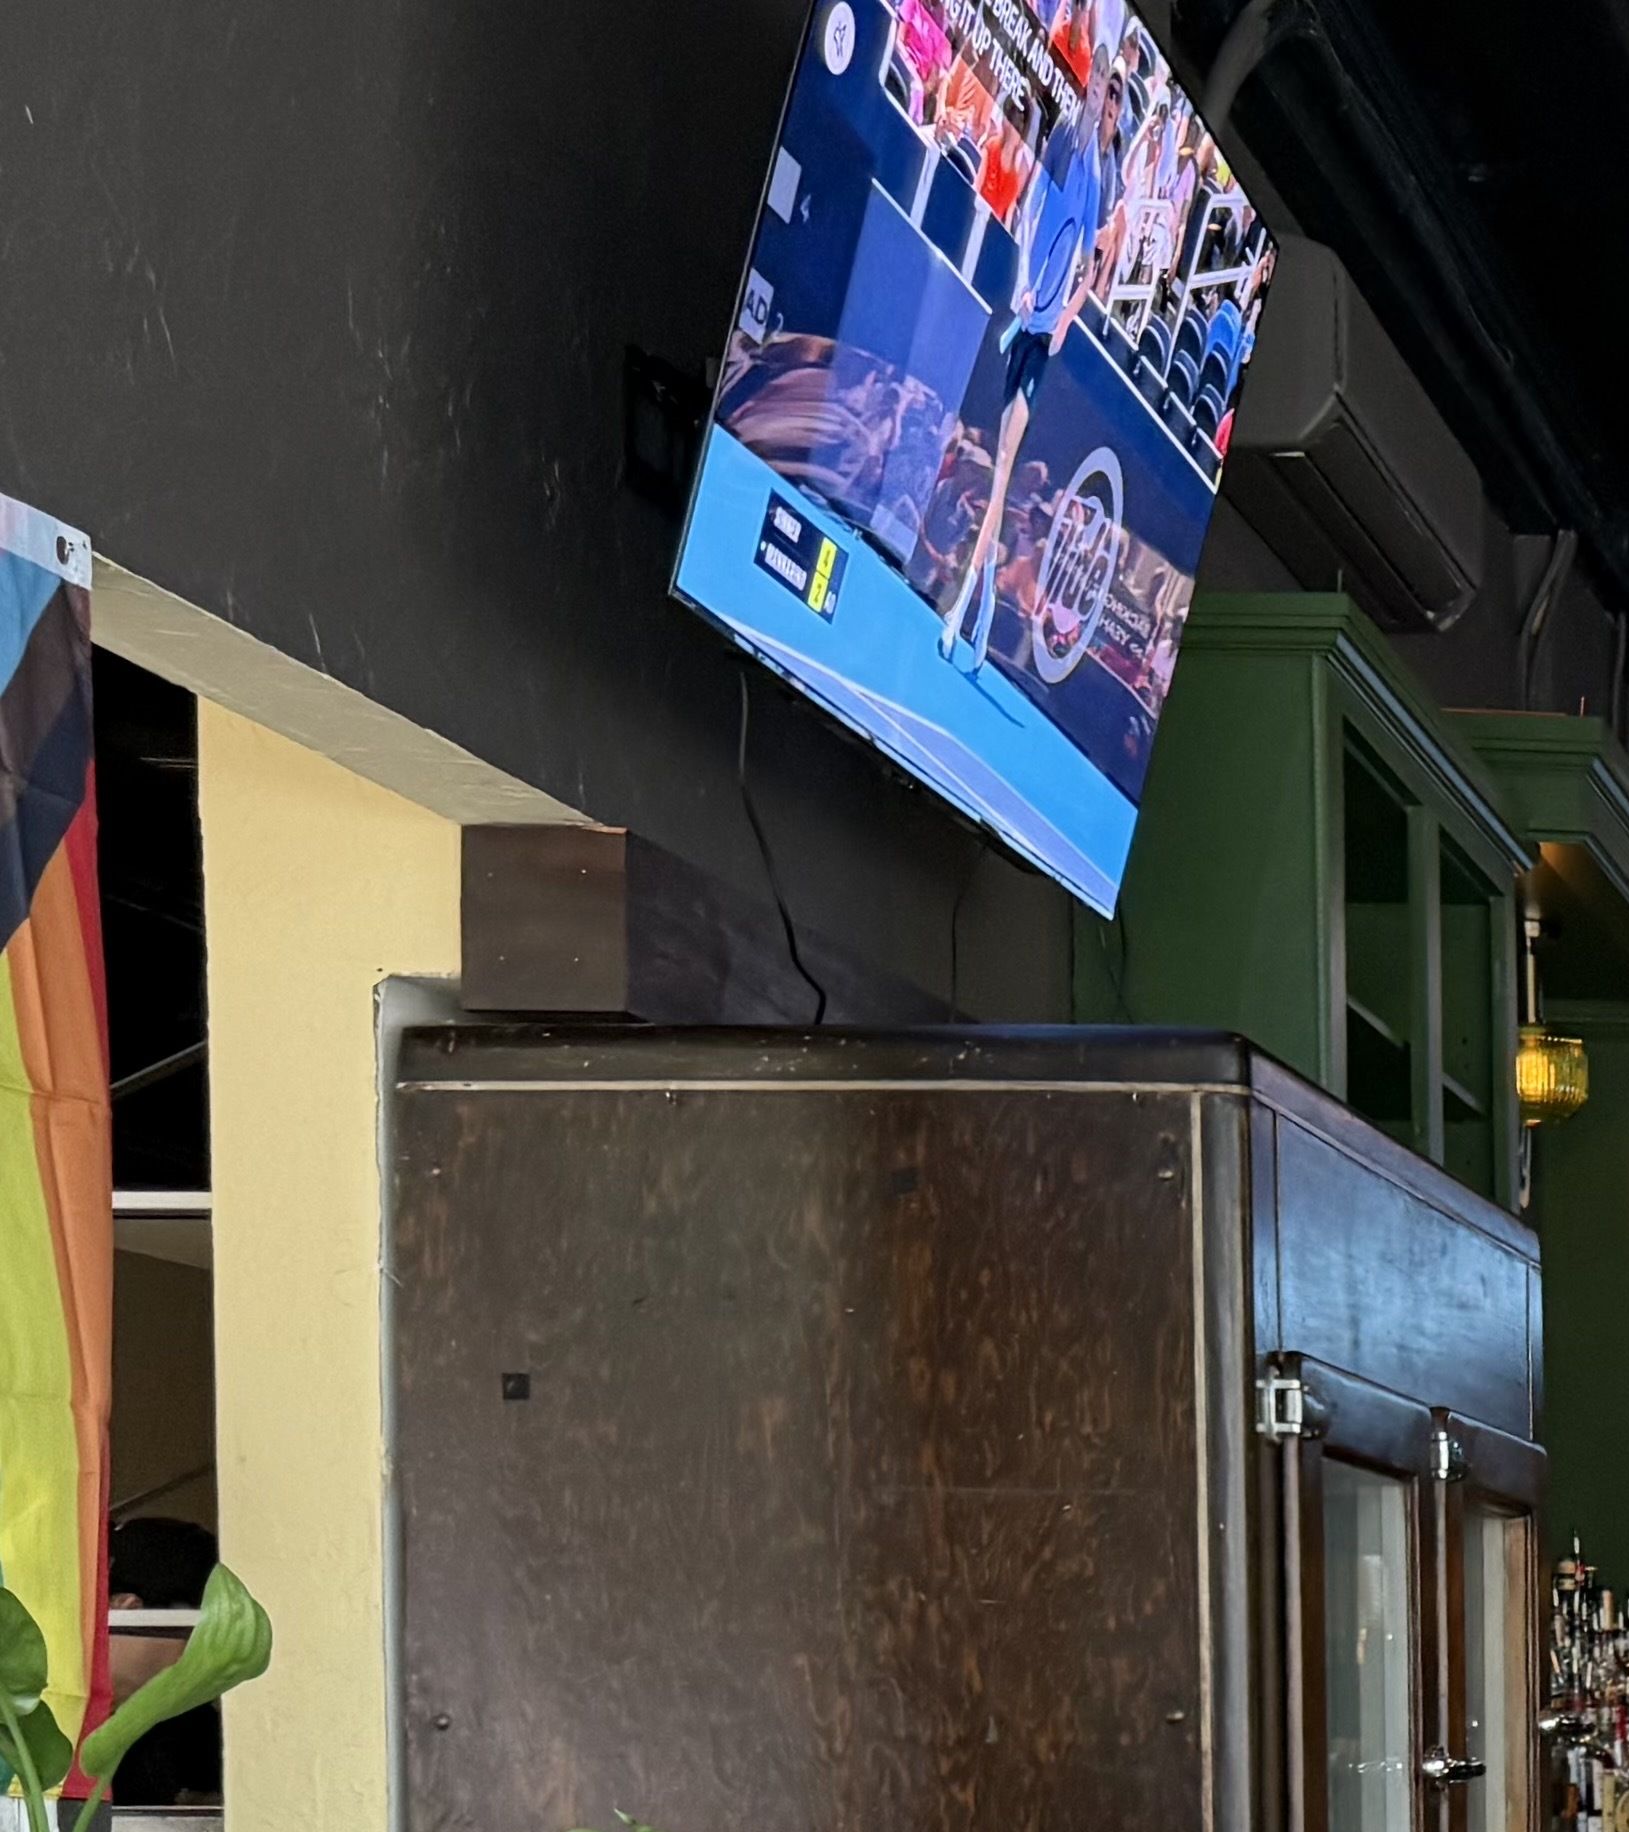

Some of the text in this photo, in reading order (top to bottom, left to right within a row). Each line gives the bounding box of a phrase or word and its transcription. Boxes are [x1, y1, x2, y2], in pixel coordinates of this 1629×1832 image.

[958, 3, 976, 36] IT
[972, 21, 992, 56] UP
[993, 0, 1033, 57] BREAK
[1027, 38, 1054, 87] AND
